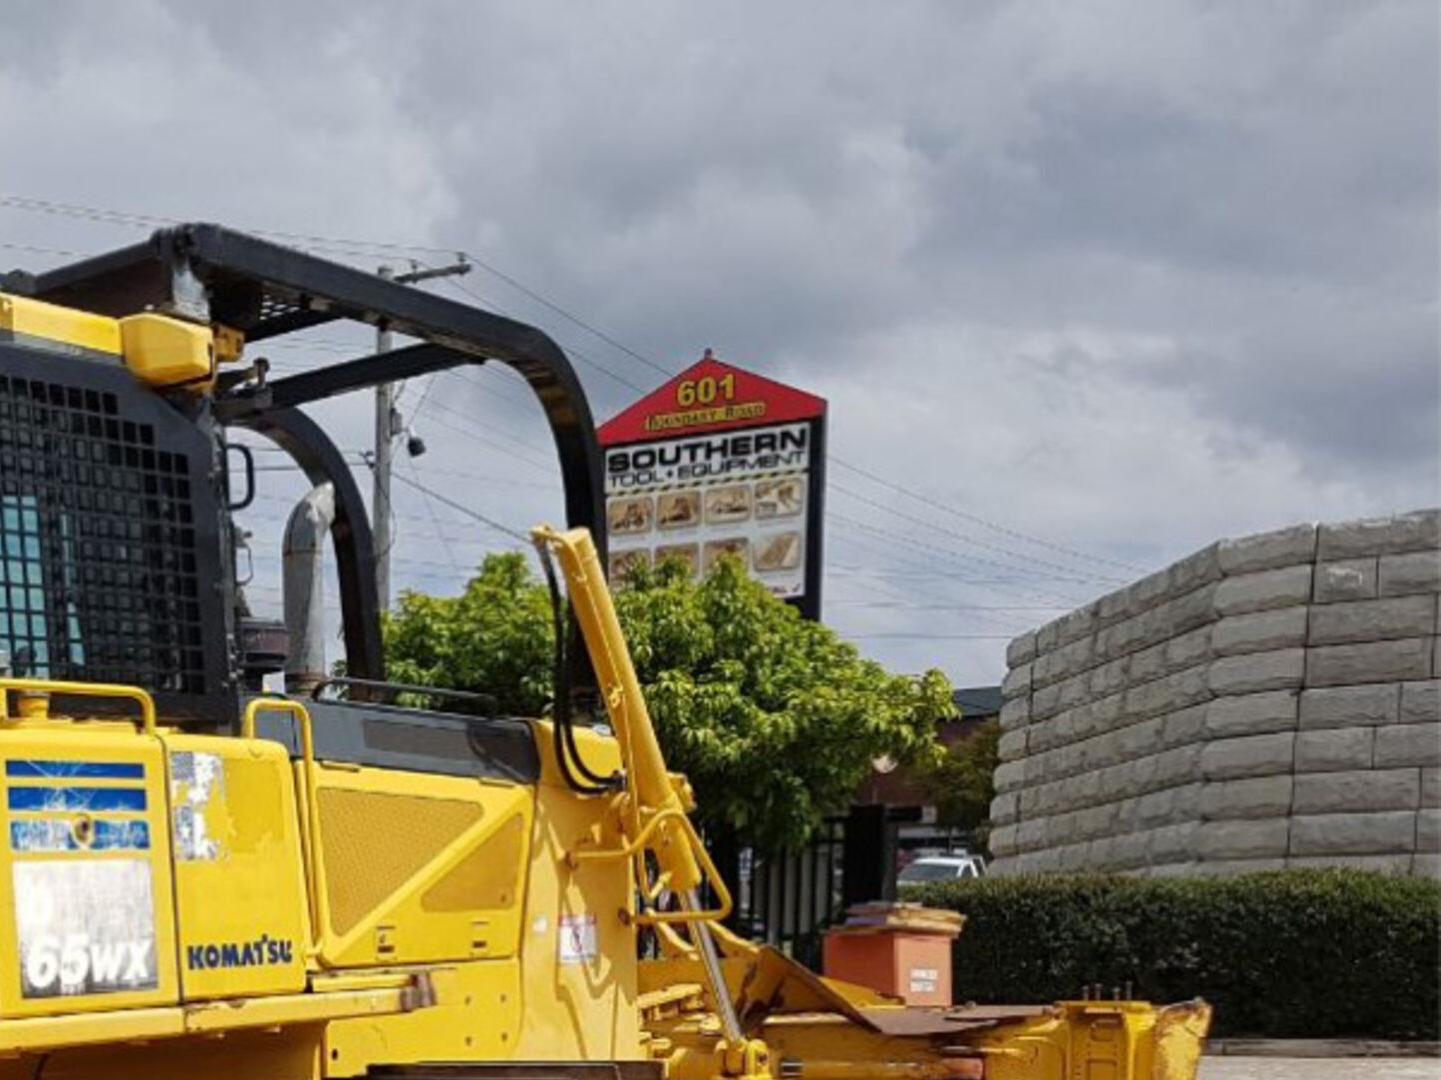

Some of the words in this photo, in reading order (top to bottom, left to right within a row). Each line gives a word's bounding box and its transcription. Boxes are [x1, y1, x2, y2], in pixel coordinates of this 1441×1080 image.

[676, 374, 736, 406] 601
[609, 427, 807, 473] SOUTHERN
[610, 467, 663, 488] TOOL
[677, 451, 805, 479] EQUIPMENT
[187, 933, 293, 970] KOMATSU
